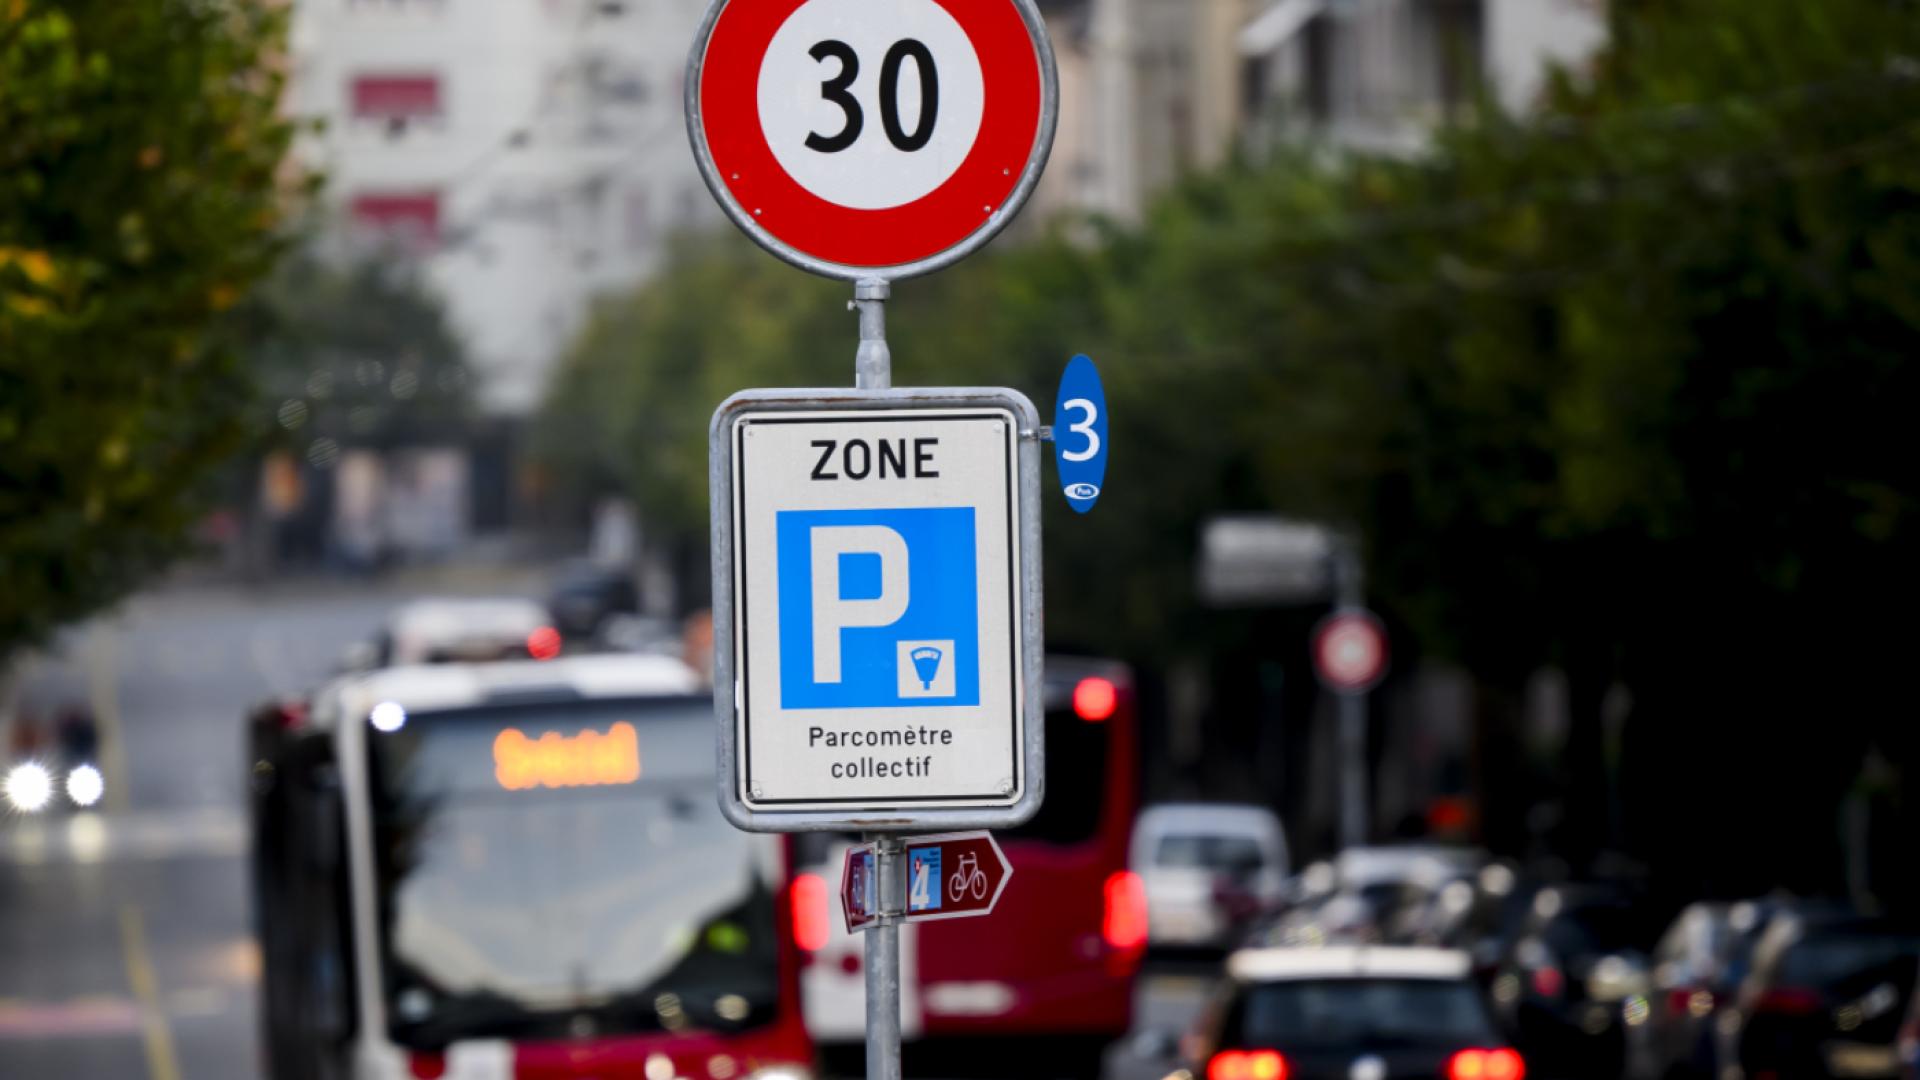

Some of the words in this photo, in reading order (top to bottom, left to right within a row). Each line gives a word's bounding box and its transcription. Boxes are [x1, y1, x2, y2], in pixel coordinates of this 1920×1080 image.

[805, 37, 939, 154] 30
[1062, 398, 1101, 462] 3
[810, 437, 940, 481] ZONE
[810, 525, 910, 684] P
[809, 726, 953, 747] Parcomètre
[831, 755, 931, 779] collectif
[909, 864, 930, 911] 4
